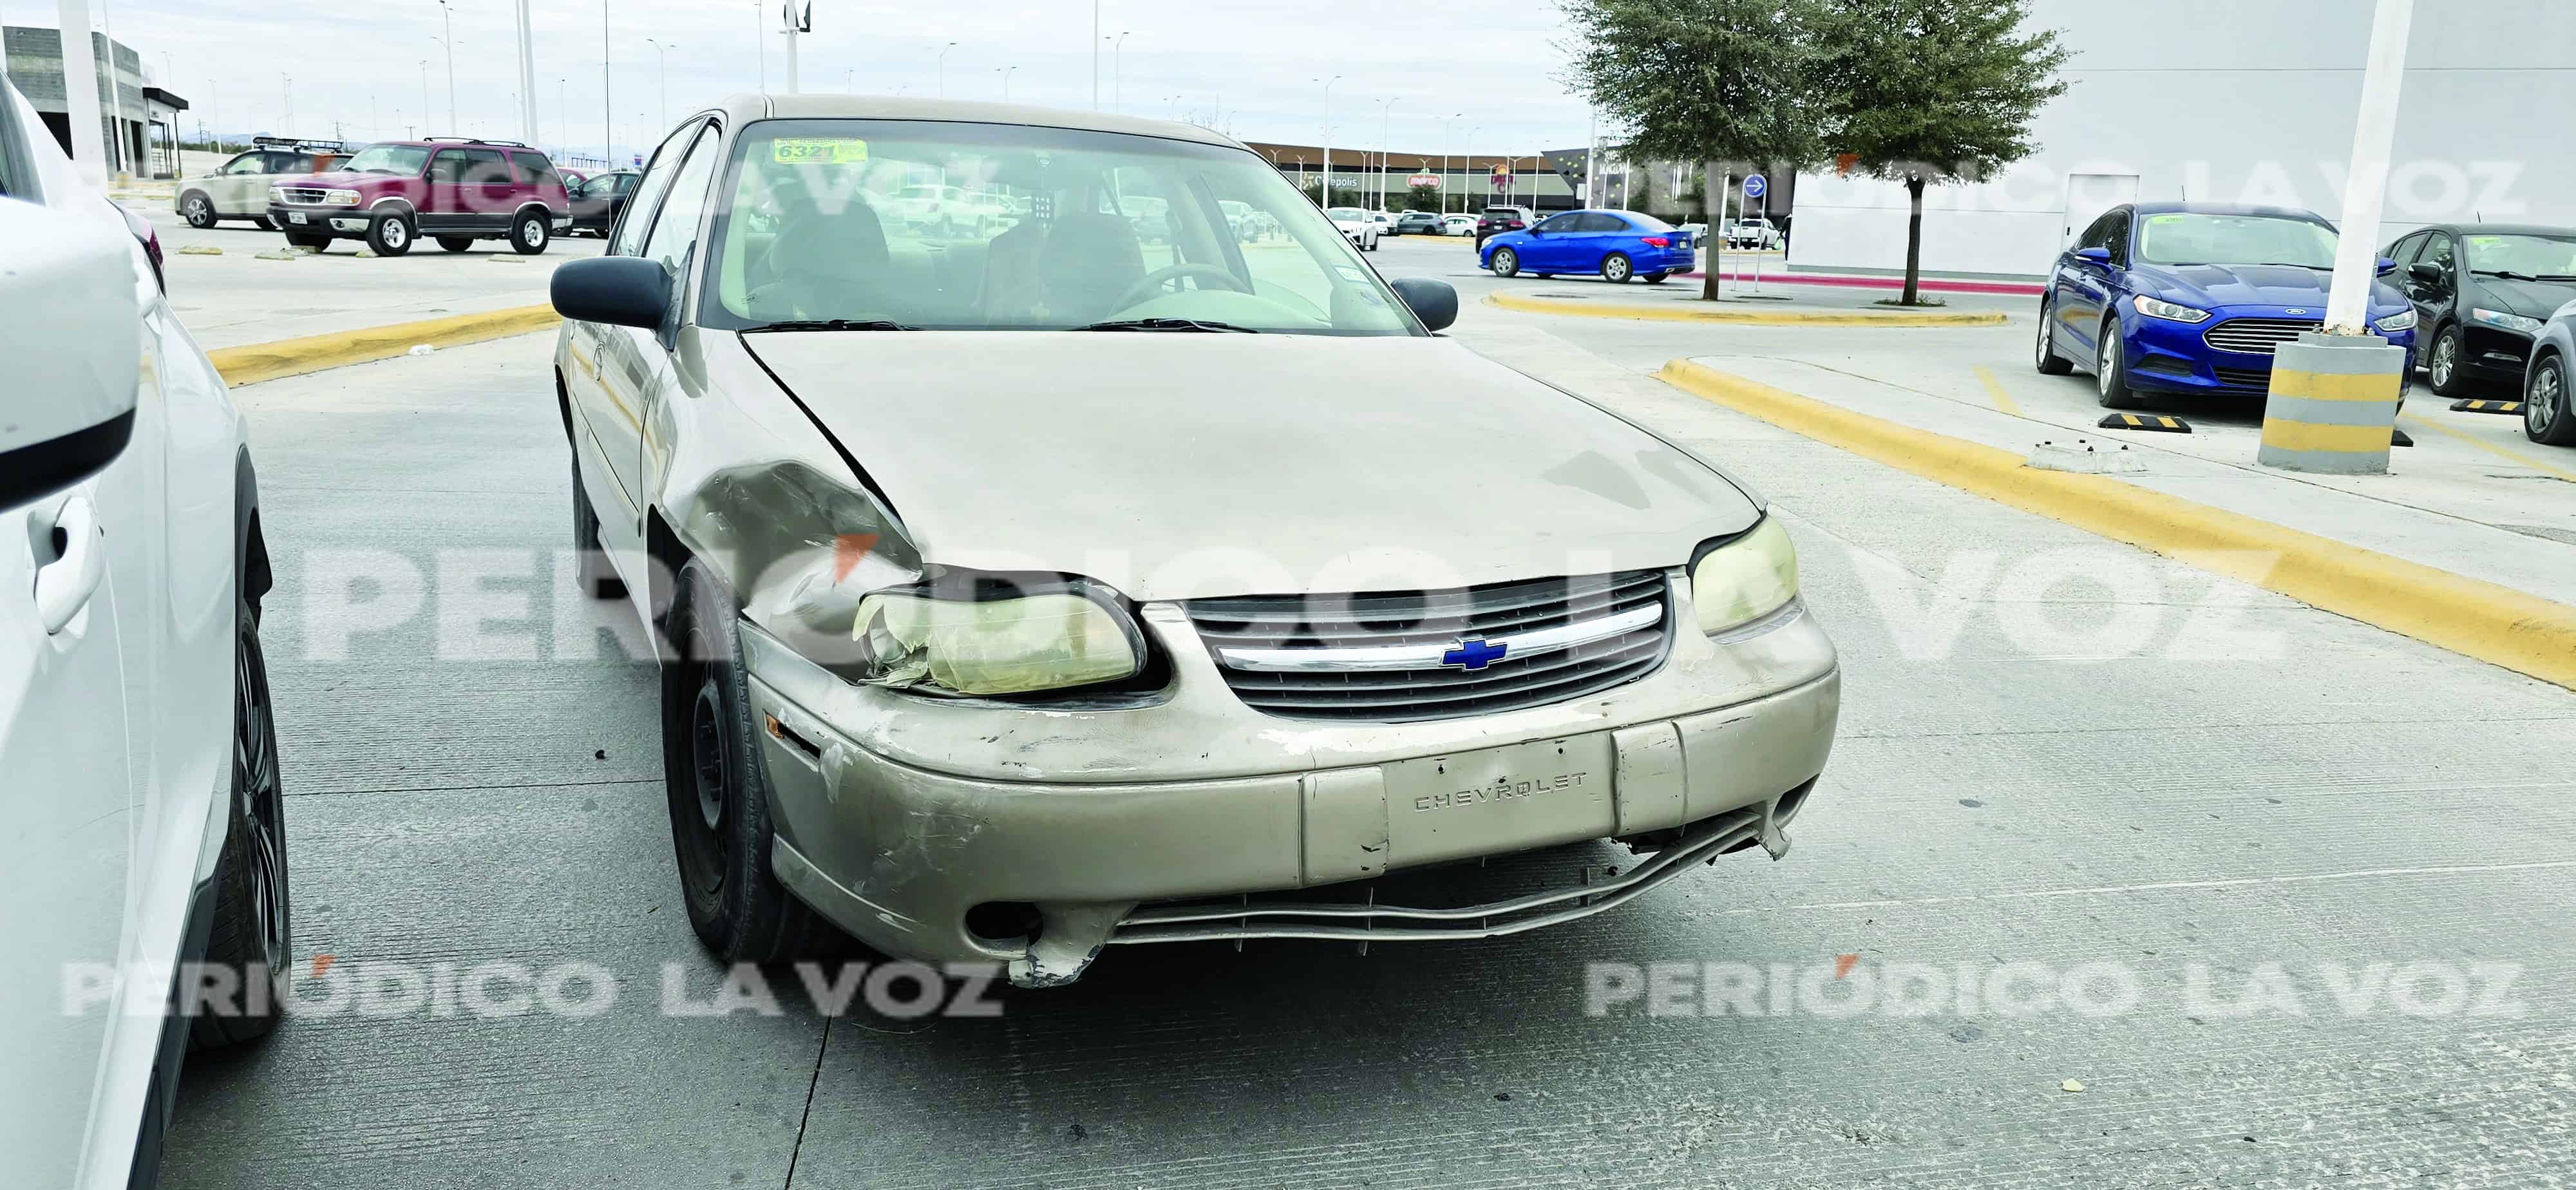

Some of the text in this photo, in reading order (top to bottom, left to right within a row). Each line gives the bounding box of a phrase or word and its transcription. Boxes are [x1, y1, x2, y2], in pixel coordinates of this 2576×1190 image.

[779, 145, 835, 158] 6321
[1315, 176, 1357, 187] Cepolis
[1414, 773, 1587, 811] CHEVROLET
